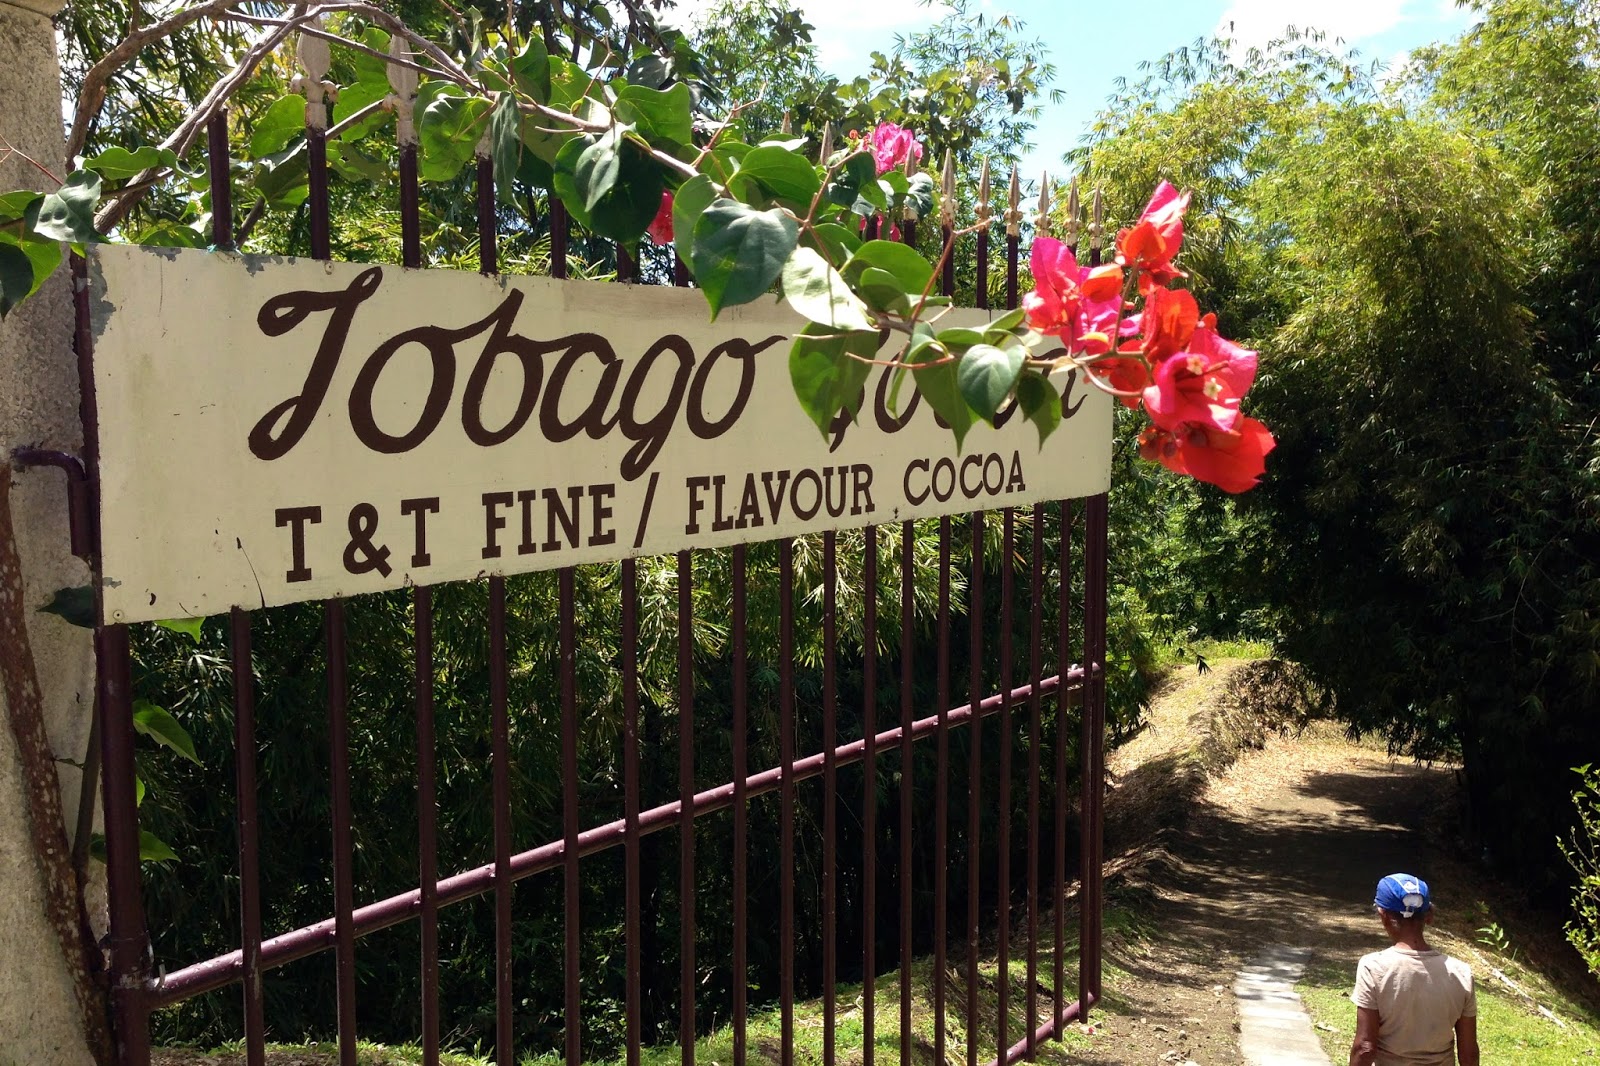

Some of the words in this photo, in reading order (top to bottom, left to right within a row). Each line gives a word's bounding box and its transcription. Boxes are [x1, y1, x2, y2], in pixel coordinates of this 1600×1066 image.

[248, 266, 788, 482] Tobago
[481, 483, 616, 560] FINE
[685, 463, 876, 536] FLAVOUR
[903, 450, 1026, 507] COCOA
